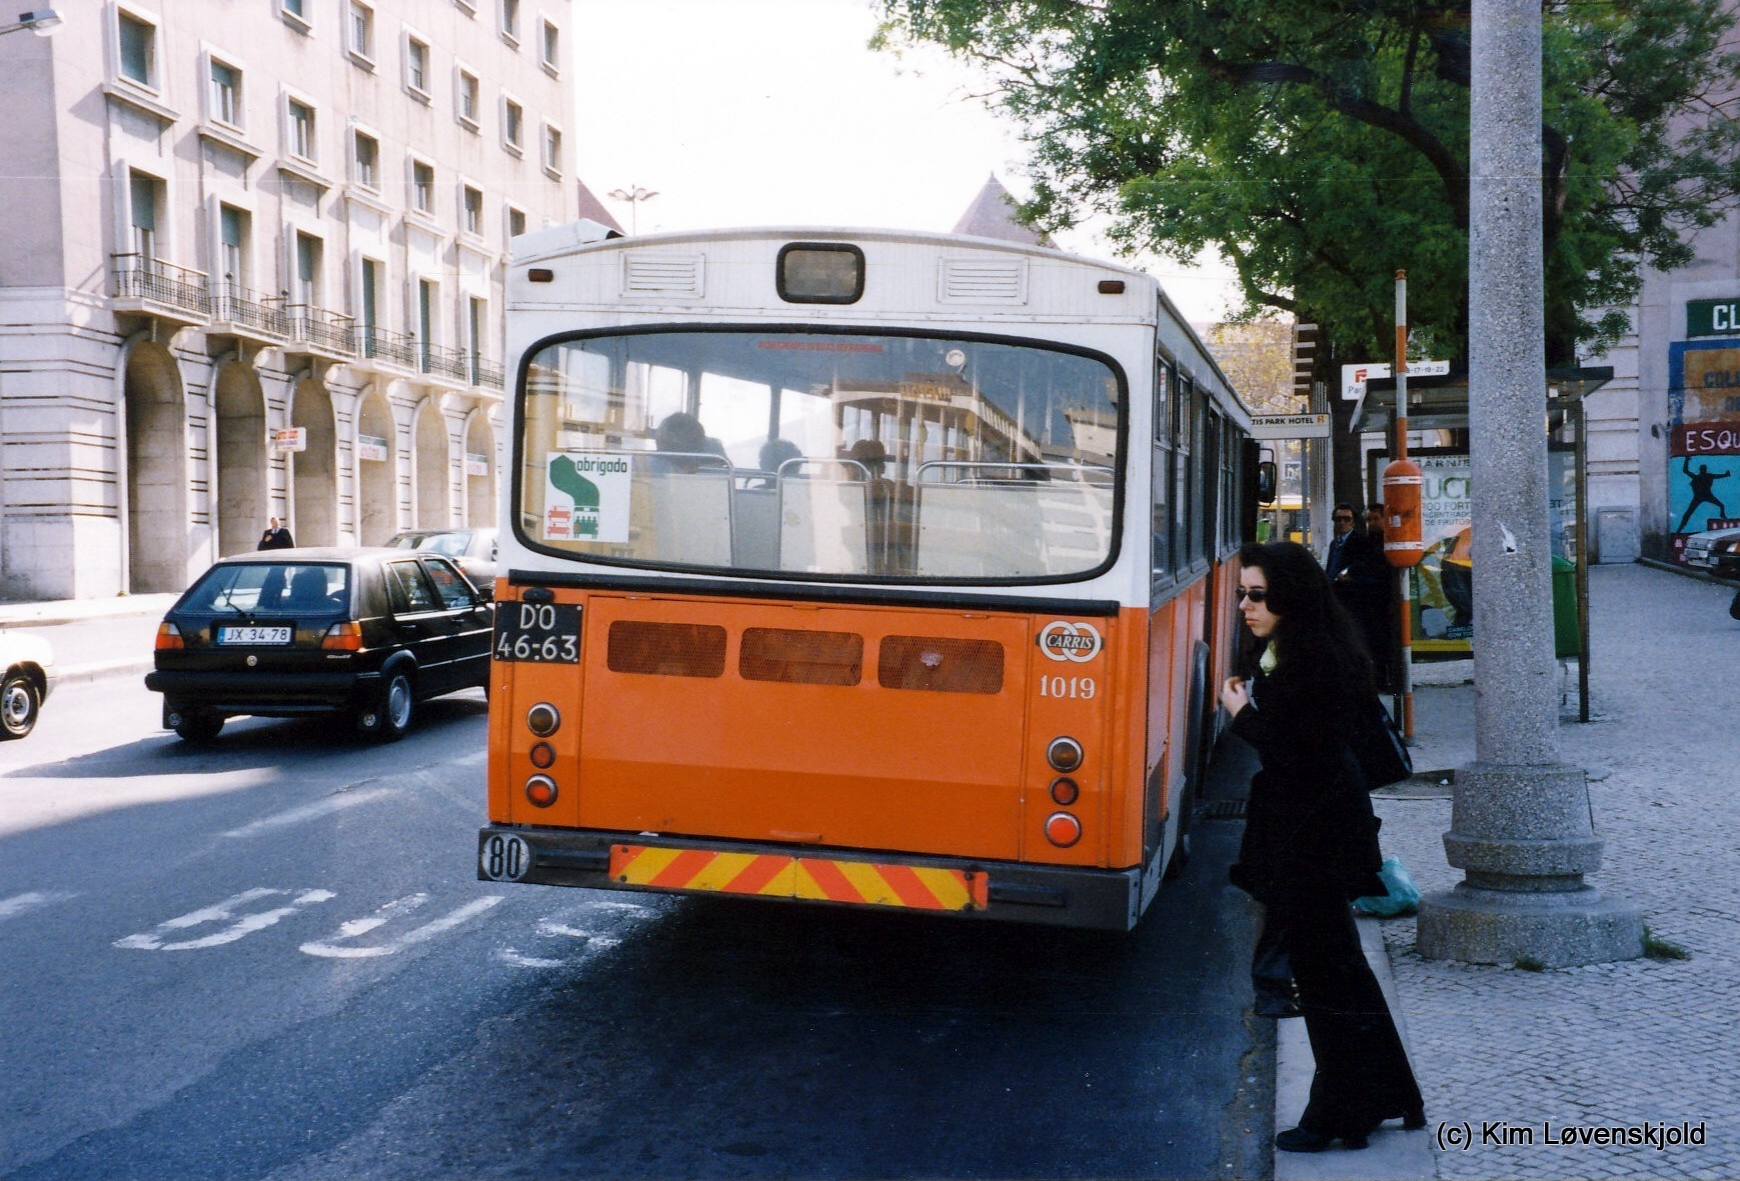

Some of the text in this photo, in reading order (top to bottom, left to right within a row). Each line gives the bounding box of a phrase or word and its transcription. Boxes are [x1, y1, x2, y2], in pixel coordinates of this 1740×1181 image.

[1265, 417, 1286, 425] PARK
[1288, 416, 1314, 425] HOTEL
[576, 457, 628, 476] obrigado
[520, 603, 556, 631] DO
[497, 631, 578, 660] 46-63
[1046, 634, 1094, 649] CARRIS
[1040, 675, 1095, 699] 1019
[490, 836, 521, 878] 80
